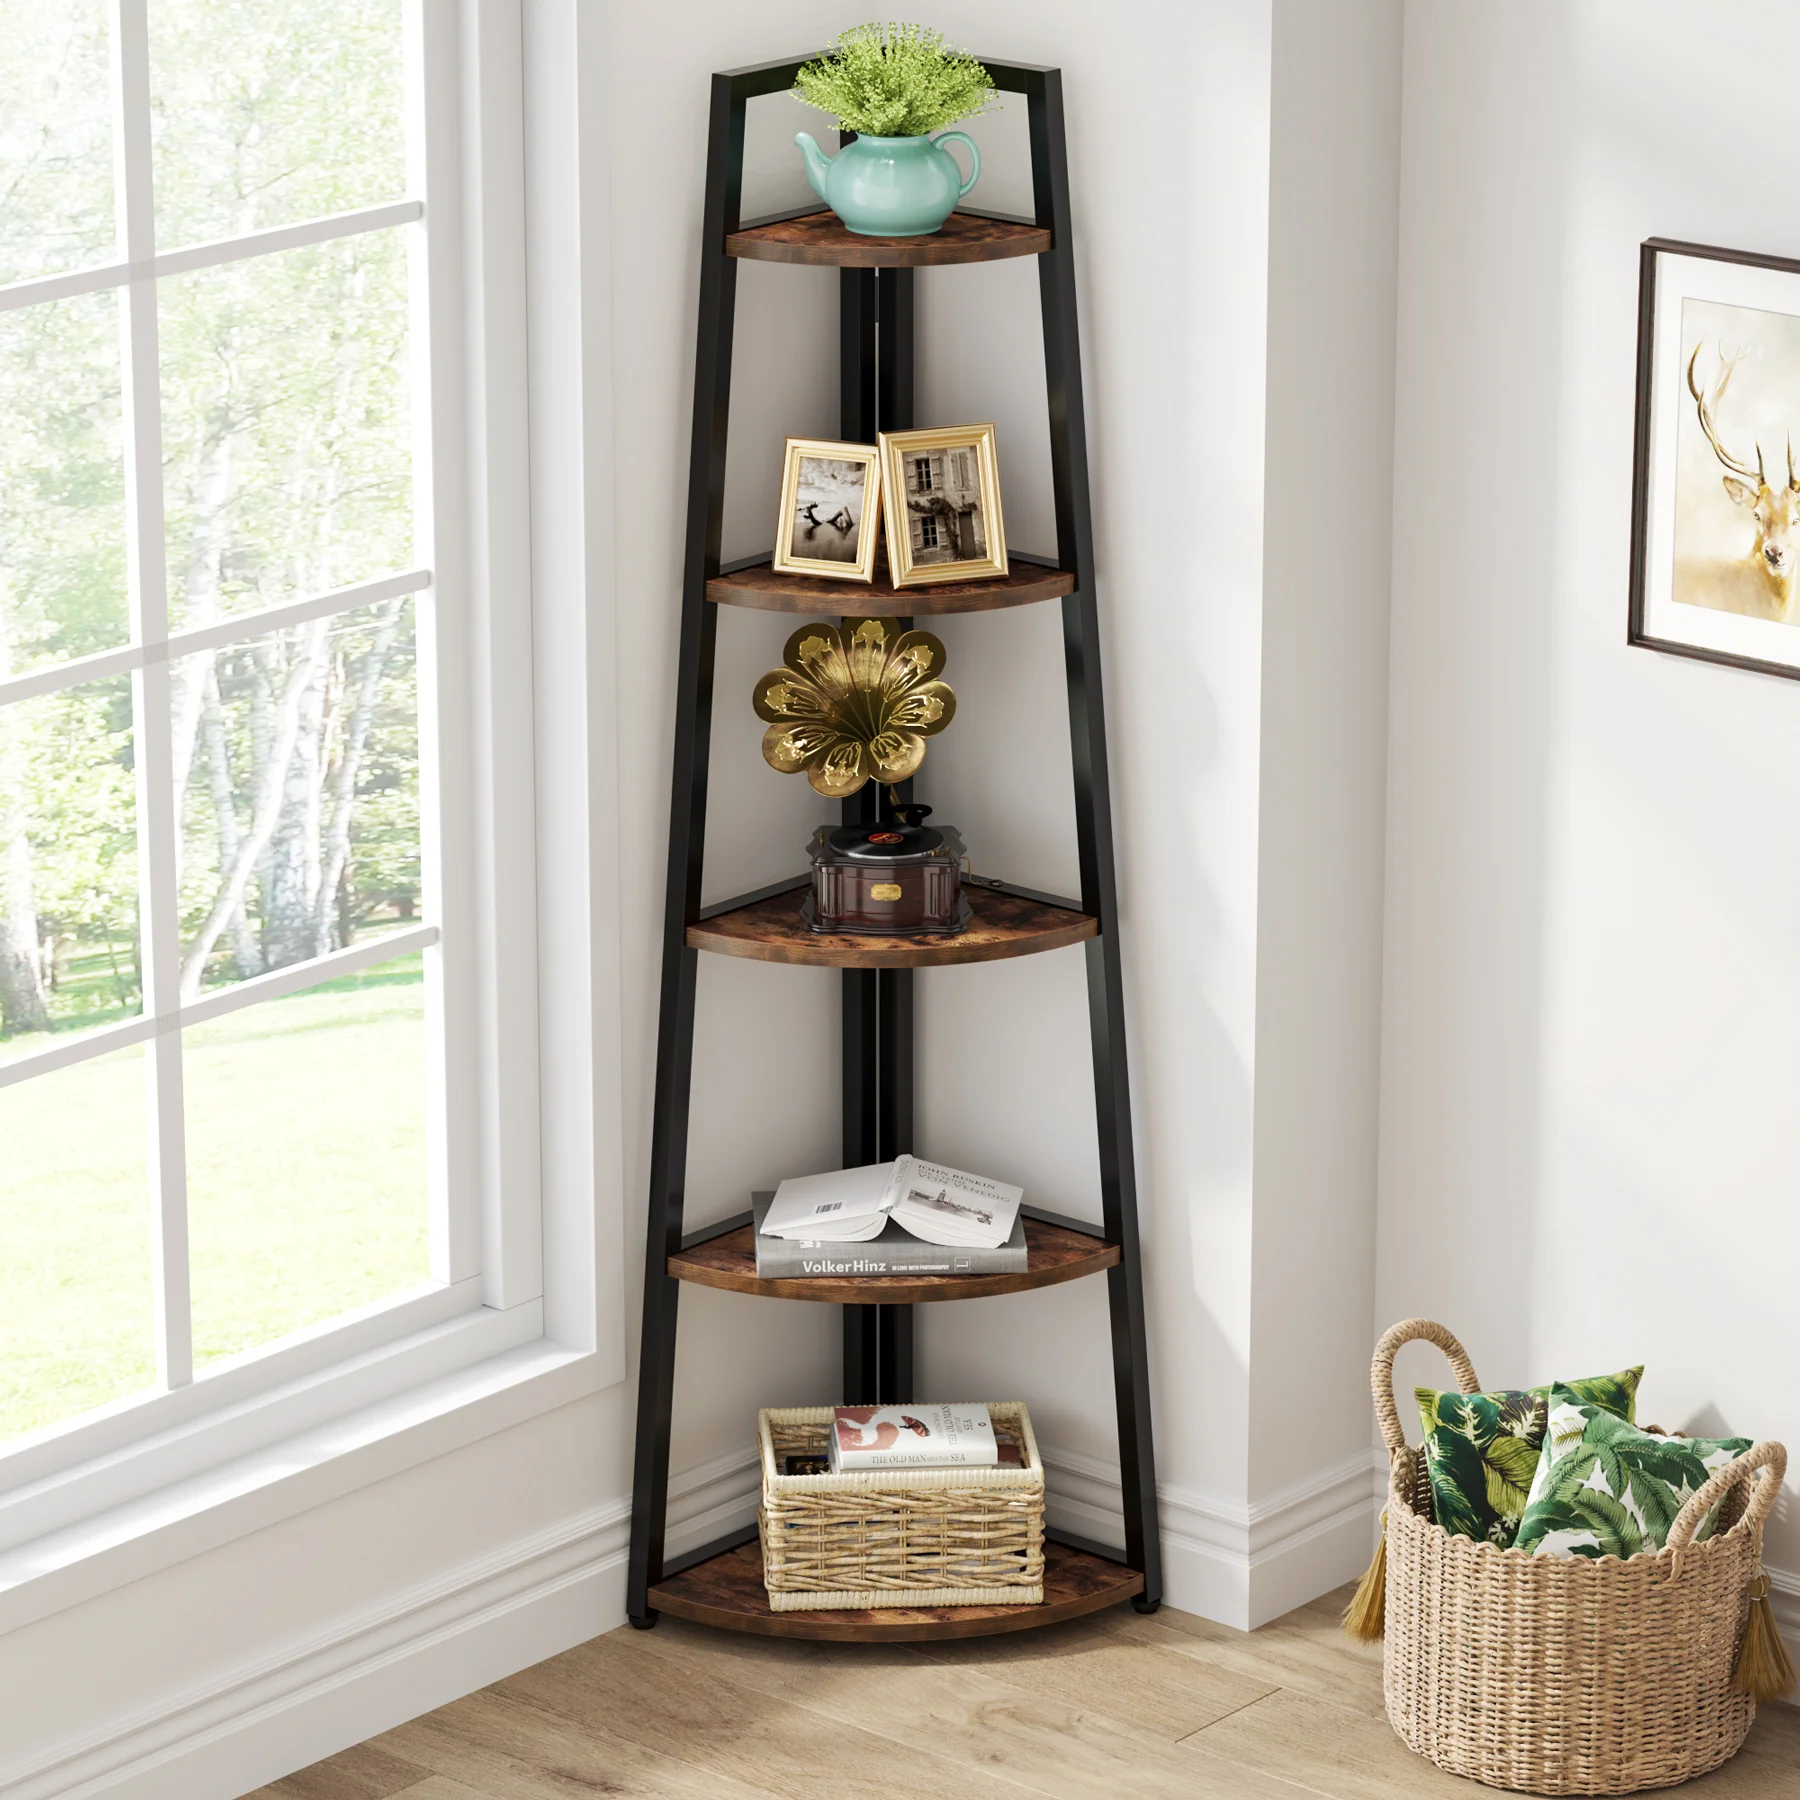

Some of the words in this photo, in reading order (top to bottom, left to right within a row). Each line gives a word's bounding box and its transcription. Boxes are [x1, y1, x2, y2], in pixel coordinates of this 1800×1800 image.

[918, 1164, 949, 1177] JOHN
[953, 1174, 996, 1190] RUSKIN
[918, 1171, 948, 1185] VON
[953, 1181, 1010, 1202] VENEDIG
[802, 1260, 852, 1273] Volker
[853, 1259, 887, 1272] Hinz
[940, 1405, 952, 1419] MAN
[944, 1419, 955, 1433] OLD
[963, 1418, 973, 1431] SEA
[947, 1433, 958, 1446] THE
[871, 1455, 888, 1464] THE
[889, 1455, 907, 1464] OLD
[908, 1454, 926, 1463] MAN
[950, 1453, 966, 1462] SEA
